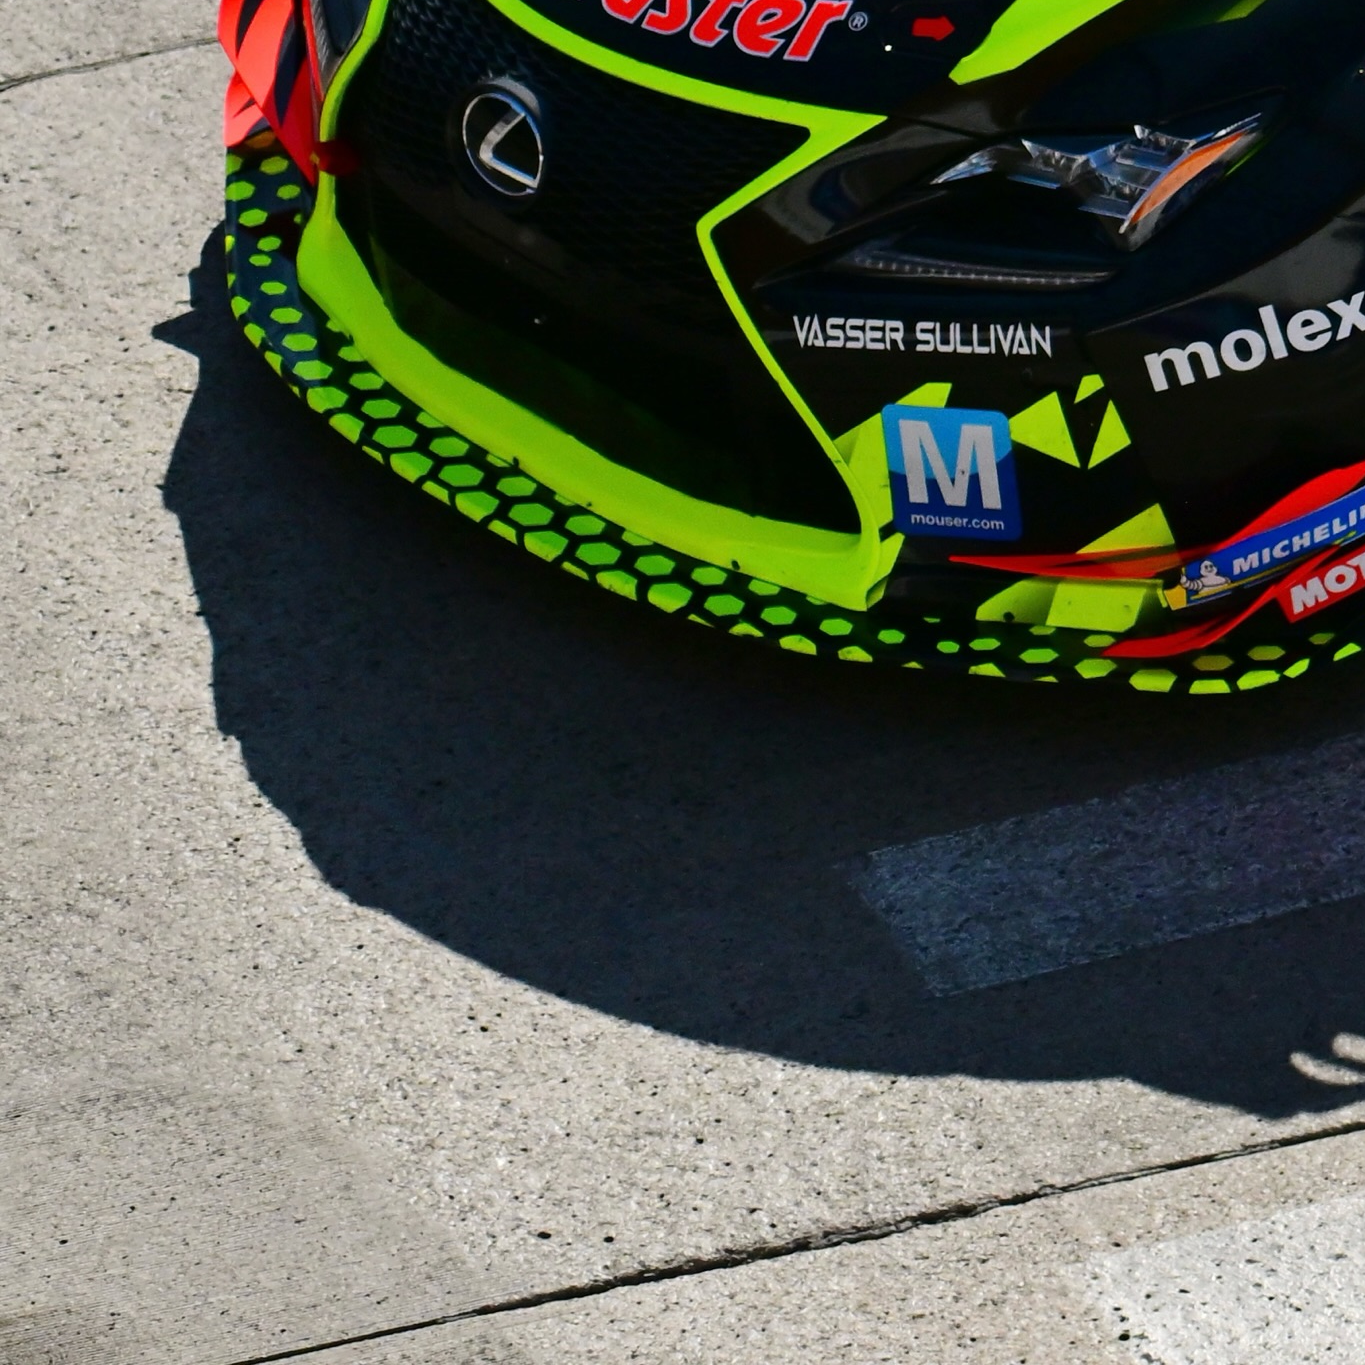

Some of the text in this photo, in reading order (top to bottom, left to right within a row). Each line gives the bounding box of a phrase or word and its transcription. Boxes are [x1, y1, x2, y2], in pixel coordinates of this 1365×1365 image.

[793, 314, 1052, 358] VASSER SULLIVAN
[910, 513, 1005, 531] mouser.com
